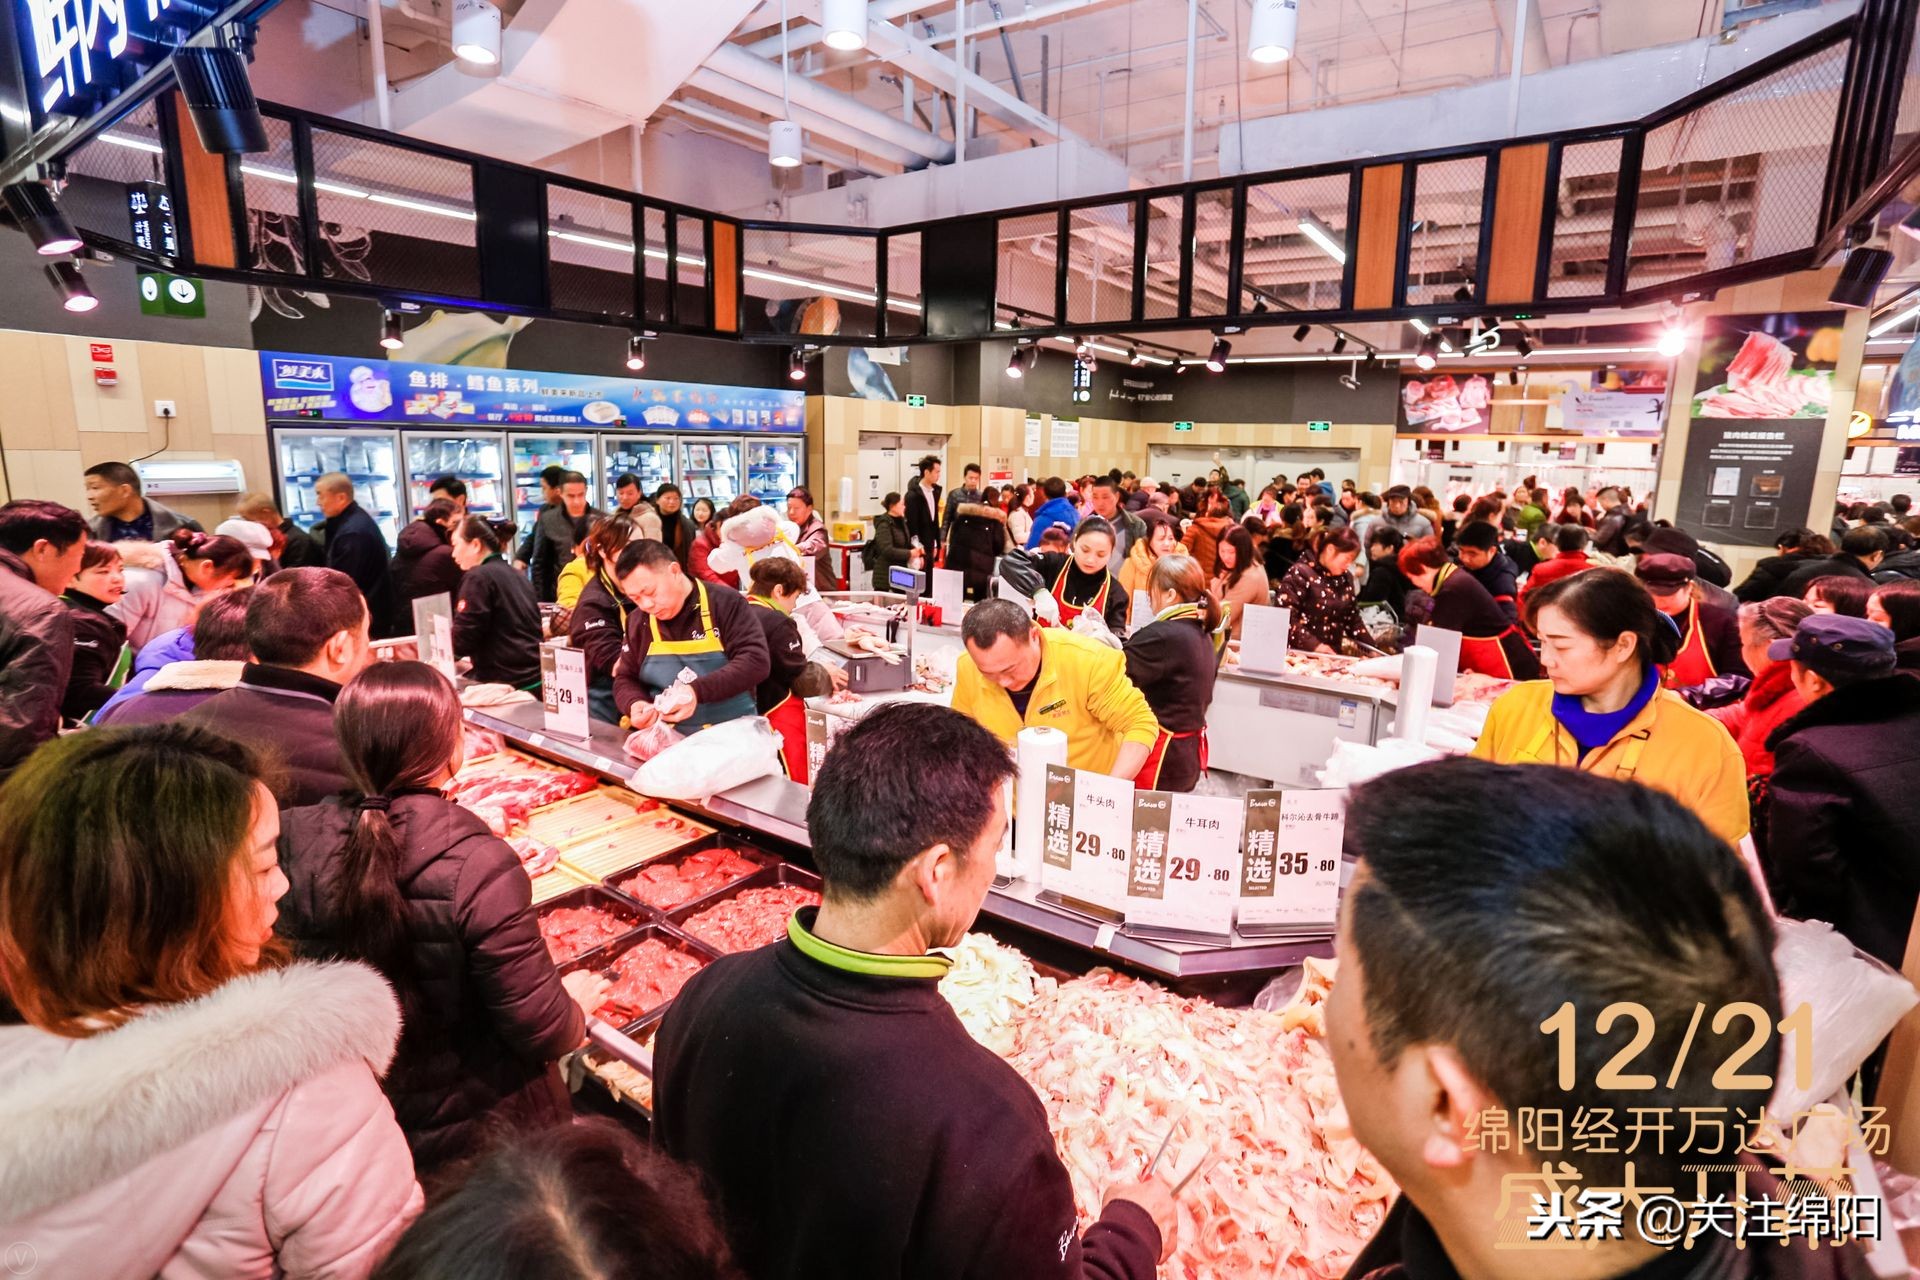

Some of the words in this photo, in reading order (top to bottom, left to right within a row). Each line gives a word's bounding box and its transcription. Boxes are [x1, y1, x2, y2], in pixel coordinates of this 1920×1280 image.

[1086, 793, 1115, 809] 牛头肉
[1185, 816, 1220, 830] 牛耳肉
[1048, 801, 1071, 857] 精选
[1246, 829, 1275, 884] 精选
[1134, 830, 1165, 885] 精选
